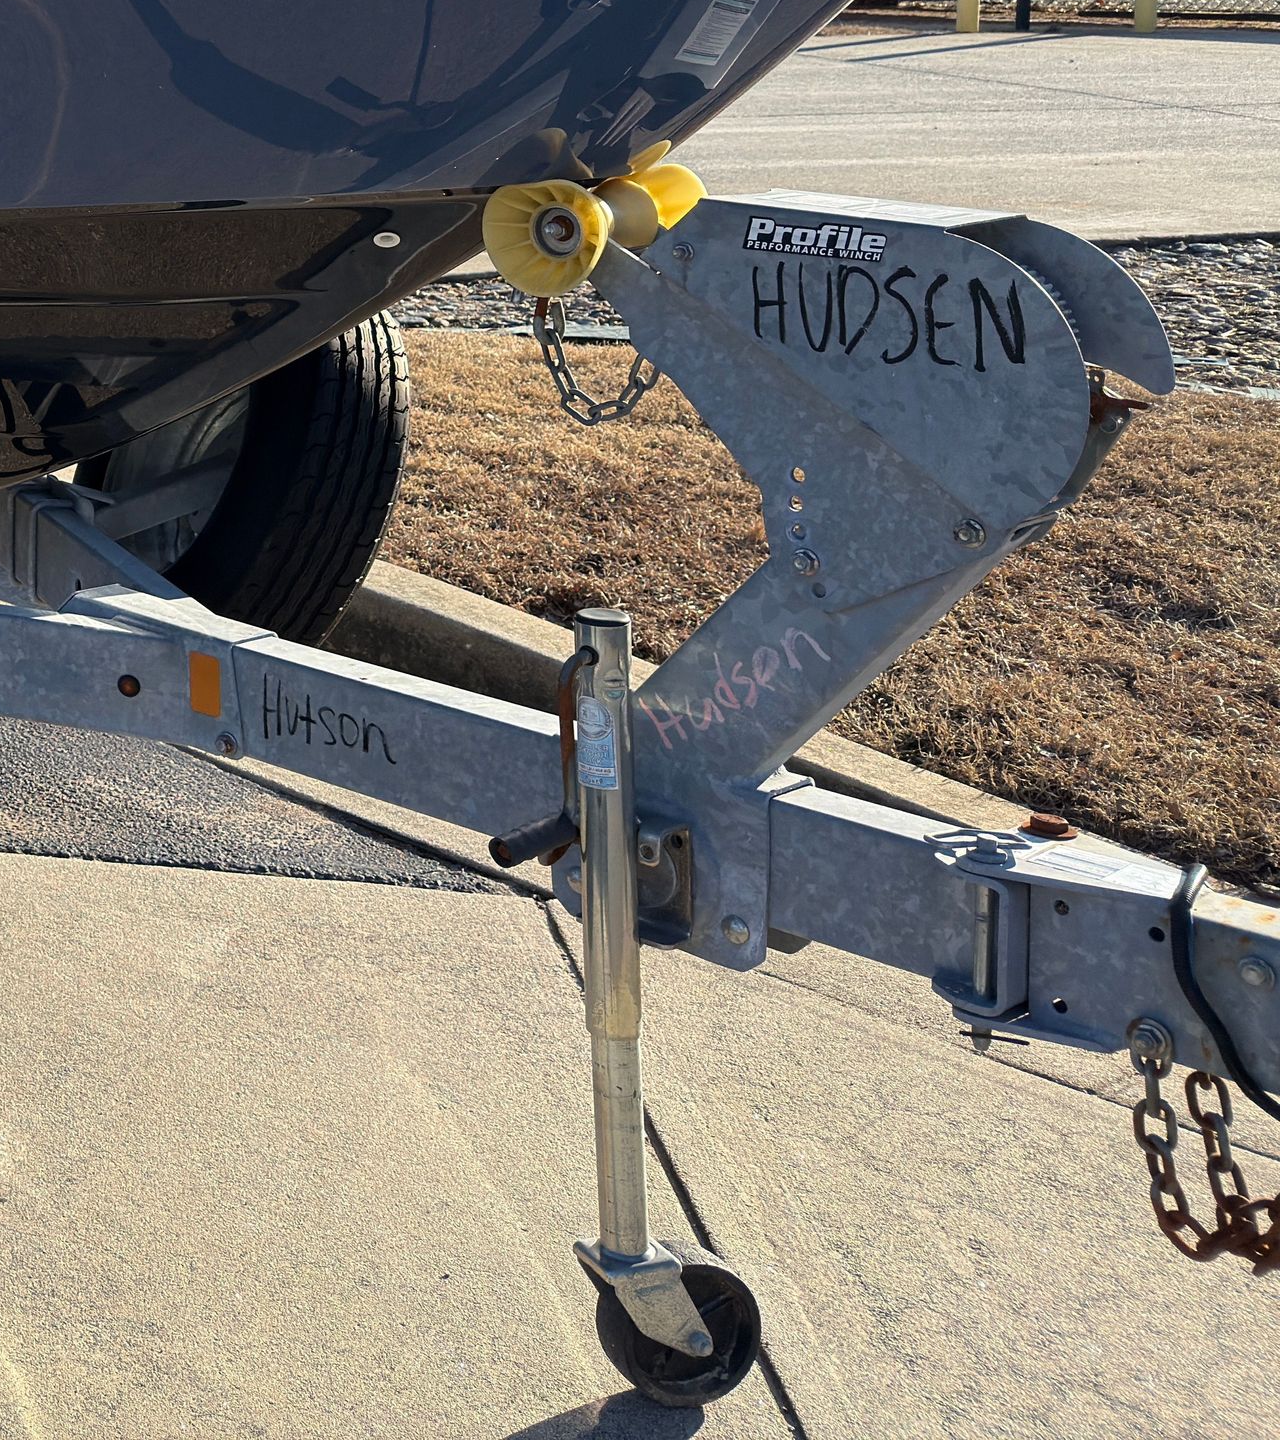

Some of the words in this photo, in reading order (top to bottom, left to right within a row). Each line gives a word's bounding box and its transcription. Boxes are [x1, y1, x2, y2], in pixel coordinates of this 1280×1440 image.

[746, 240, 835, 257] PERFORMANCE
[839, 249, 882, 262] WINCH
[747, 217, 887, 253] Profile
[751, 261, 1026, 372] HUDSEN
[263, 672, 397, 765] Hutson
